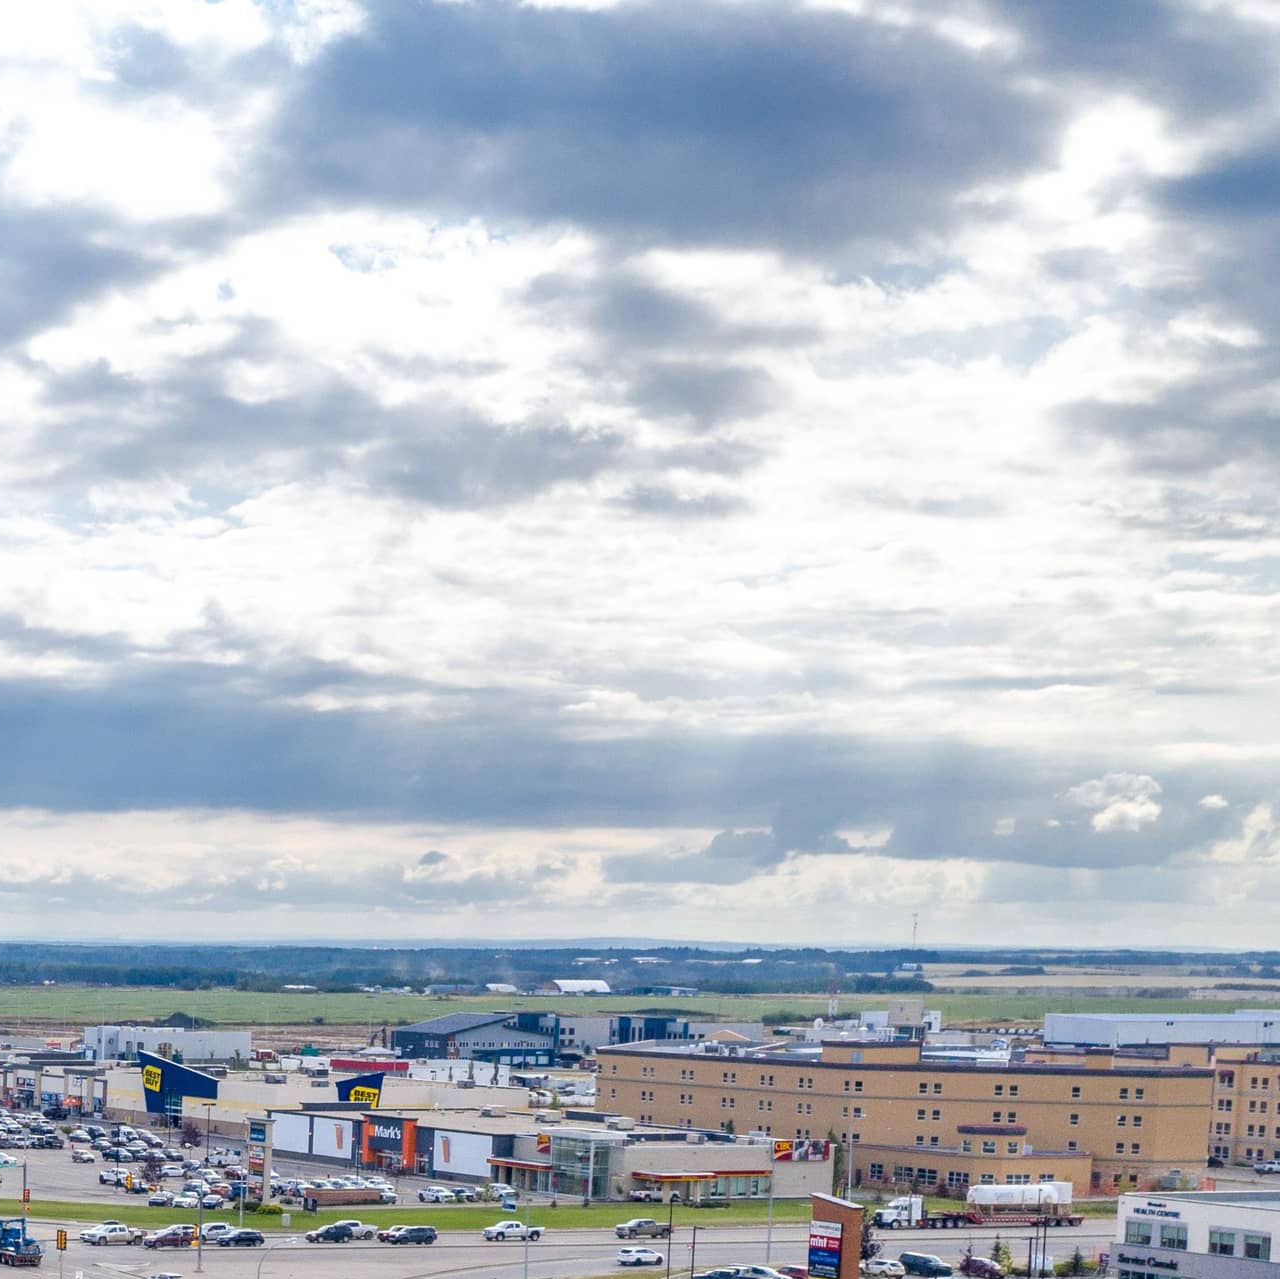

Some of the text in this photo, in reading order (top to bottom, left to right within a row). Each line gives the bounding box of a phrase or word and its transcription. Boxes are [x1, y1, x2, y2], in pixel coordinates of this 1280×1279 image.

[145, 1069, 160, 1080] BEST
[145, 1077, 159, 1088] BUY
[354, 1090, 377, 1099] BEST
[375, 1125, 401, 1139] Mark's
